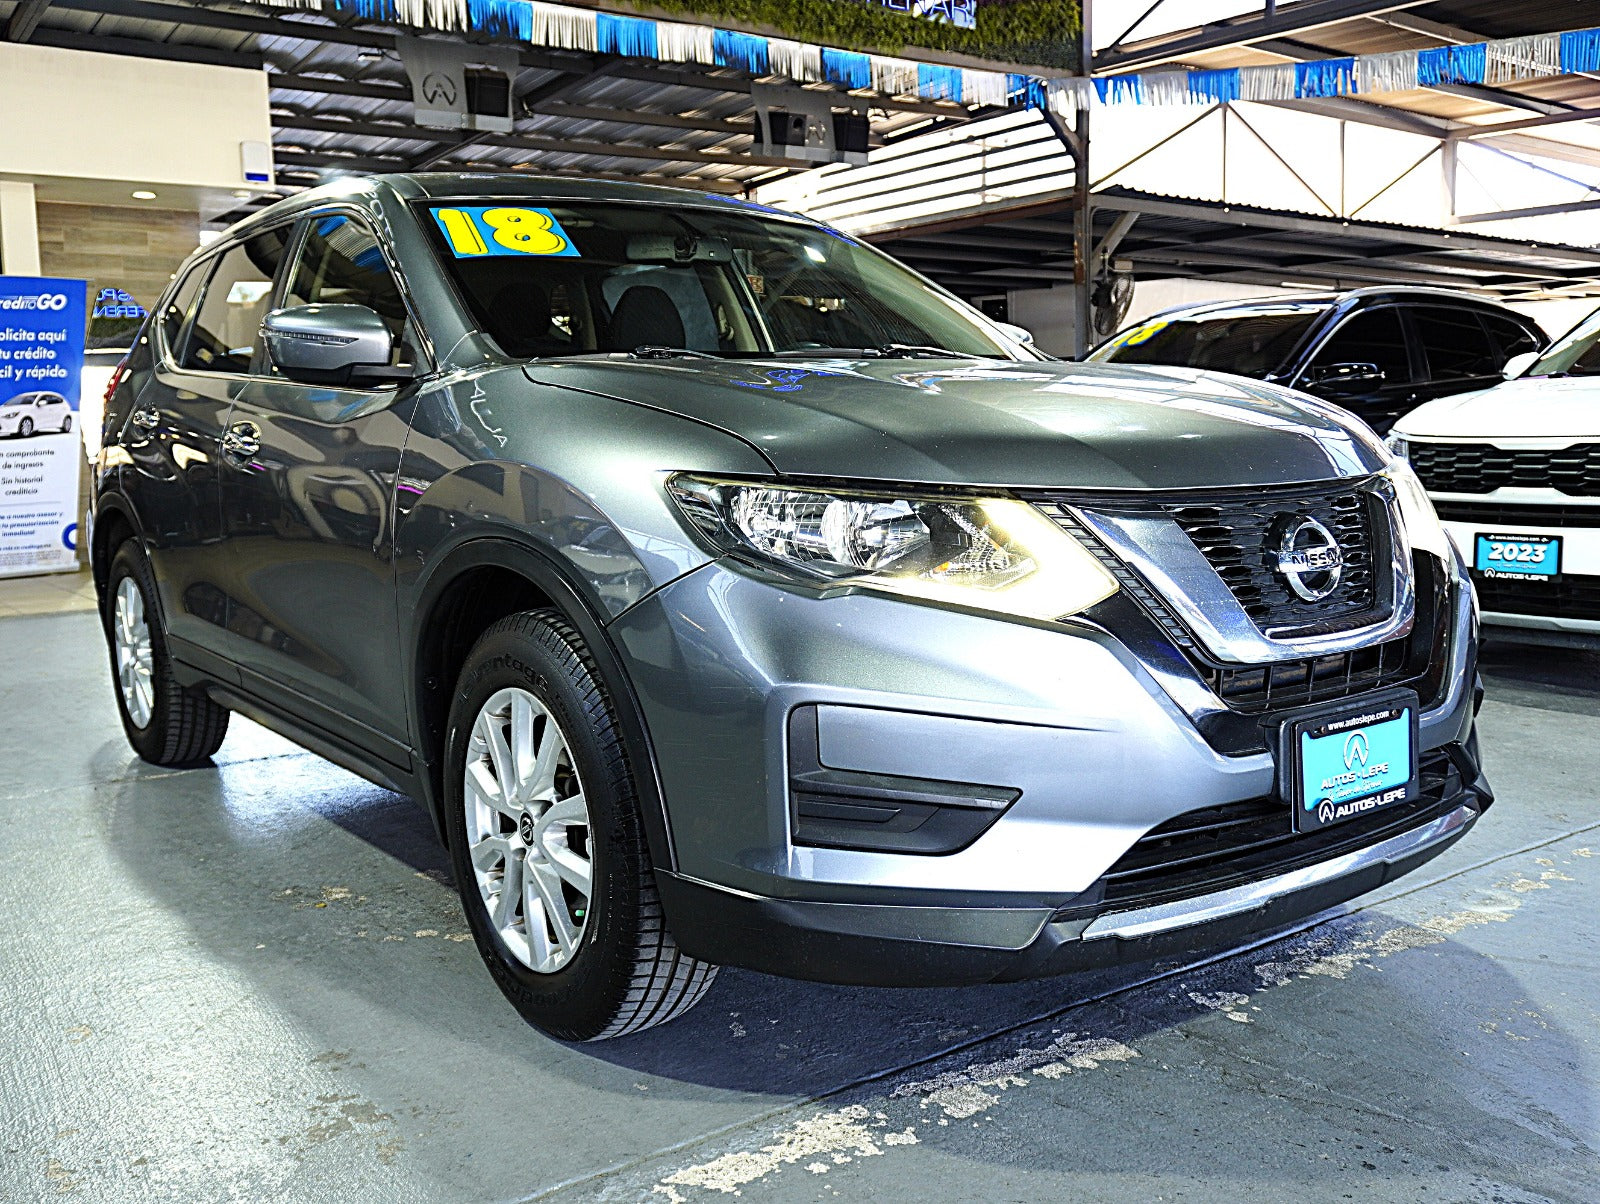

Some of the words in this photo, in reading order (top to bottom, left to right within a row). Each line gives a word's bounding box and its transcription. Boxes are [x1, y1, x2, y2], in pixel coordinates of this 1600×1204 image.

[438, 208, 567, 255] 18
[38, 328, 67, 344] aquí
[13, 346, 57, 360] crédito
[14, 368, 24, 381] y
[25, 364, 68, 381] rápido
[6, 448, 55, 459] comprobante
[14, 460, 44, 471] ingresos
[15, 475, 43, 484] historial
[1488, 542, 1548, 562] 2023
[1327, 709, 1390, 731] www.autoslepe.com
